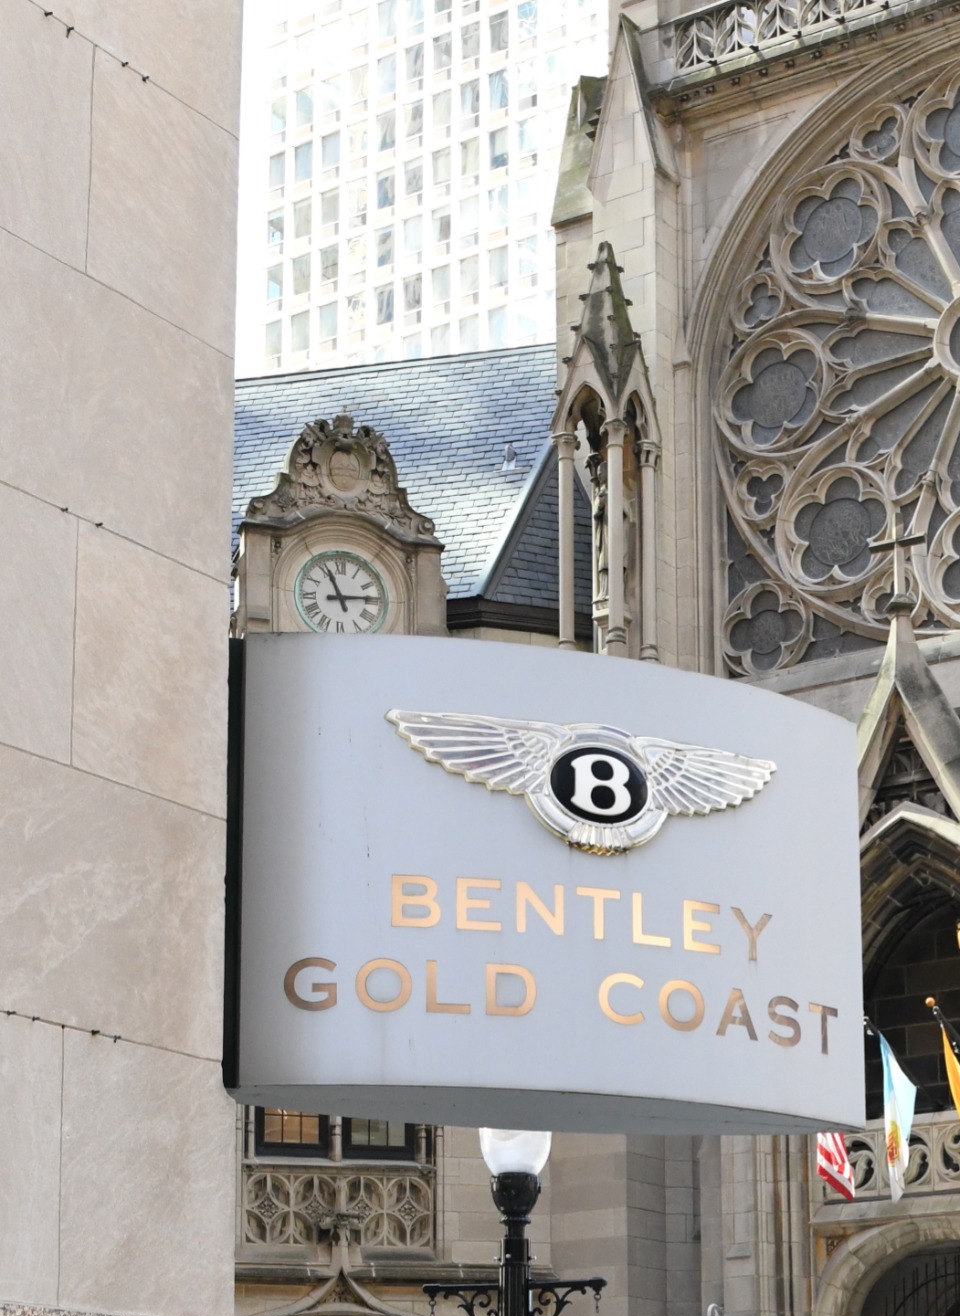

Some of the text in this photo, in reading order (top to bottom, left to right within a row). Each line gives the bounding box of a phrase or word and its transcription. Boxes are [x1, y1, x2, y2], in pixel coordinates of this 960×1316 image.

[570, 753, 632, 816] B
[391, 873, 773, 962] BENTLEY
[283, 956, 838, 1056] GOLD COAST
